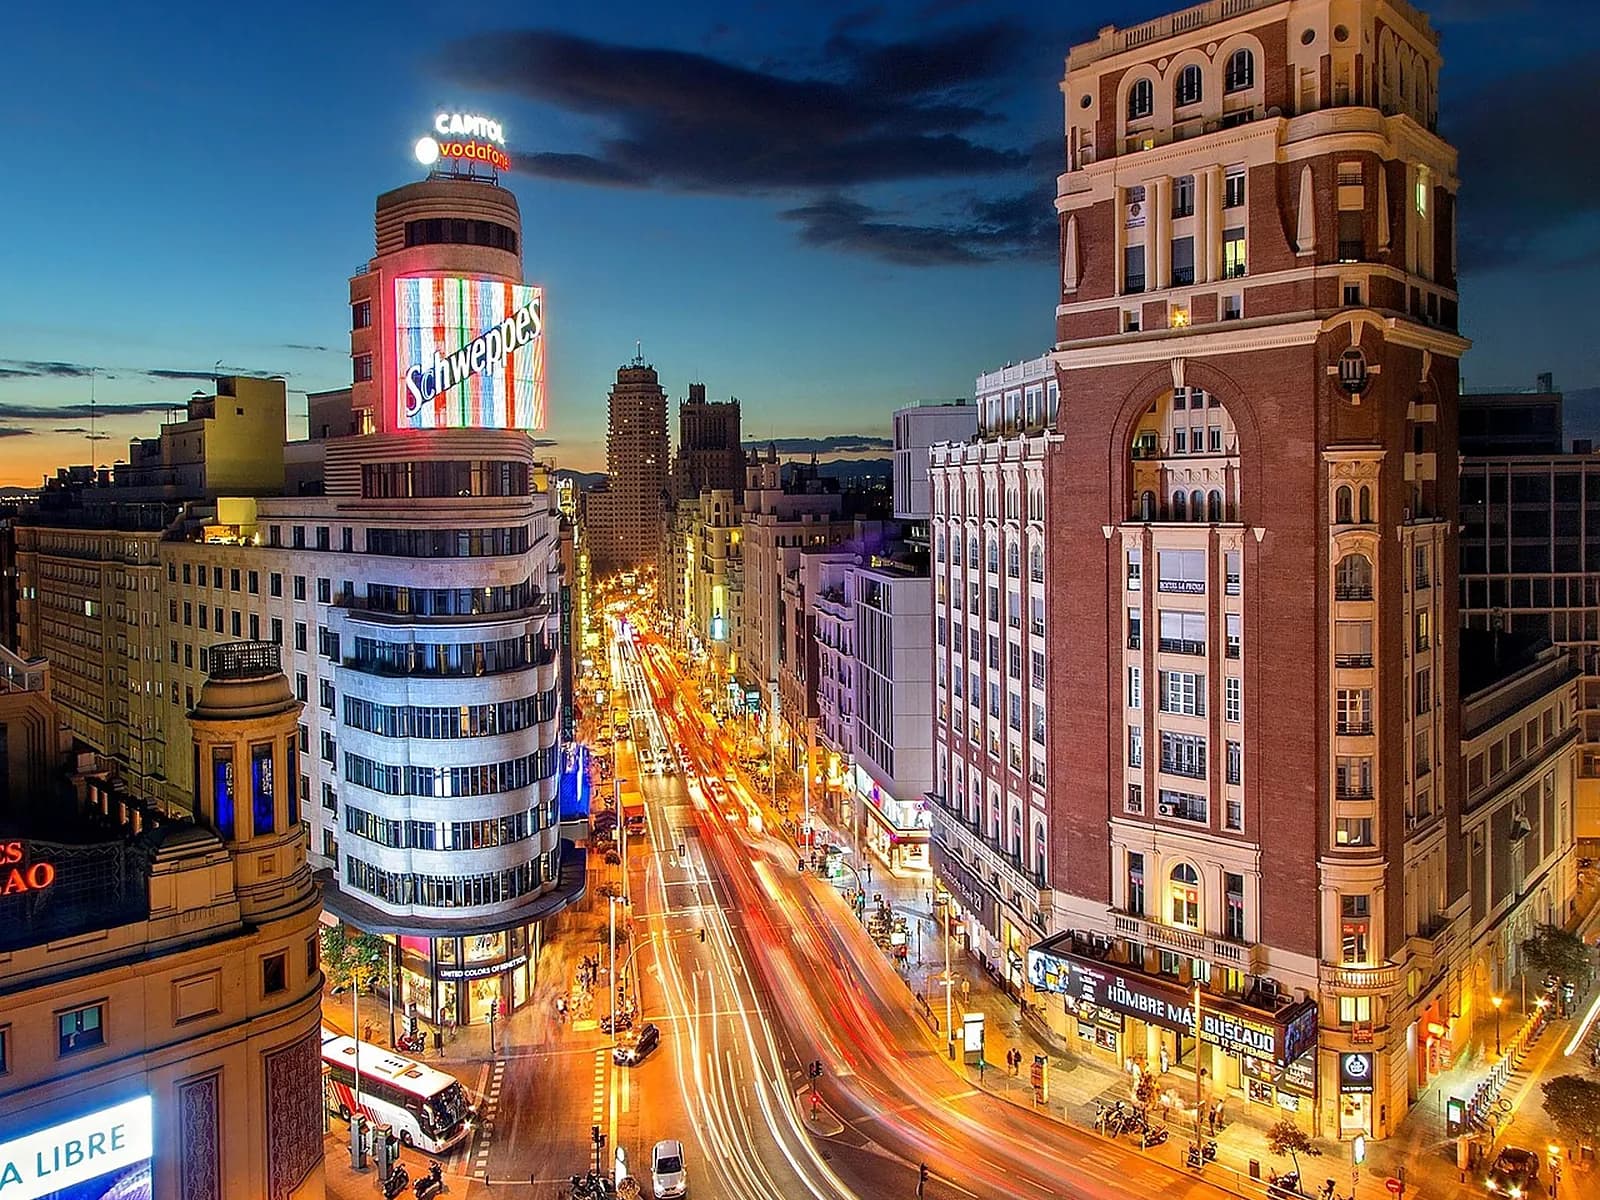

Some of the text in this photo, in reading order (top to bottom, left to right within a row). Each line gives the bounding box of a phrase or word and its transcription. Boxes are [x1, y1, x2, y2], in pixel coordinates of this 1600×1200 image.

[435, 113, 505, 145] CAPITOL
[406, 297, 541, 417] Schweppes
[562, 589, 572, 739] HOTEL REX
[0, 863, 54, 895] AO
[440, 970, 463, 978] UNITED
[464, 968, 490, 977] COLORS
[1116, 976, 1126, 989] EL
[1107, 985, 1165, 1017] HOMBRE
[1204, 1015, 1275, 1053] BUSCADO
[36, 1123, 126, 1178] LIBRE
